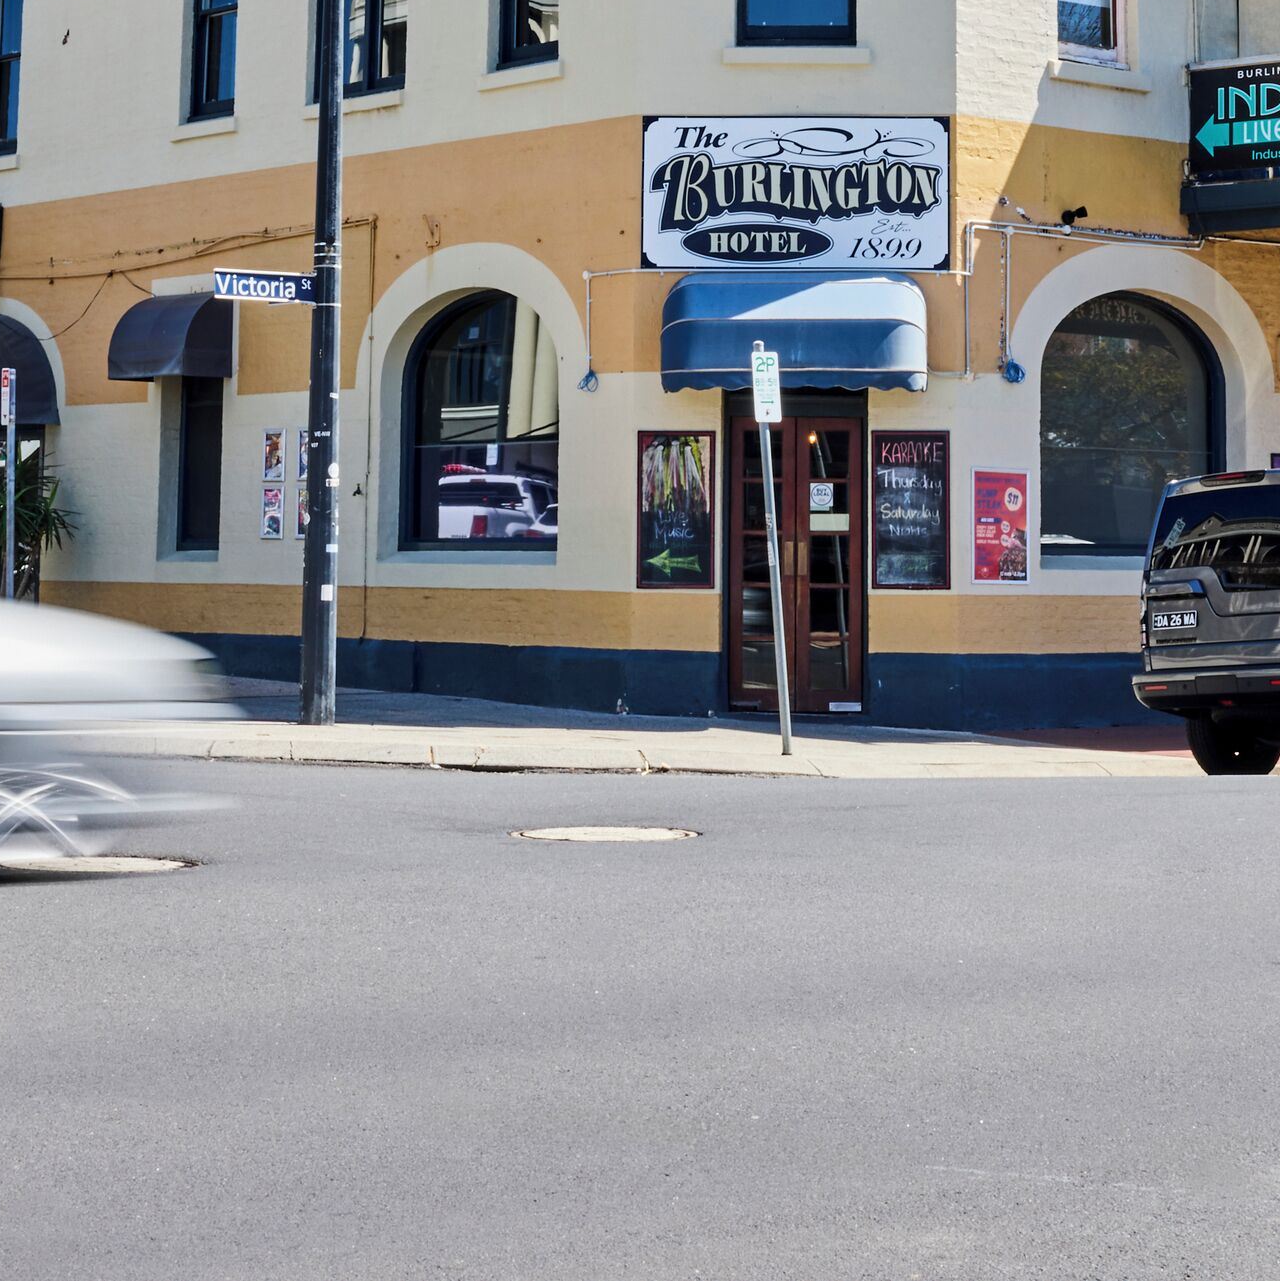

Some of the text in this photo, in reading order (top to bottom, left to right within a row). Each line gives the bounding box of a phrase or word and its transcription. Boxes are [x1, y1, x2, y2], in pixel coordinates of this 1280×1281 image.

[674, 126, 728, 148] The
[664, 154, 939, 221] BURLINGTON
[709, 232, 807, 254] HOTEL
[847, 237, 922, 259] 1899
[215, 273, 311, 298] Victoria St
[755, 356, 775, 372] 2P
[881, 441, 943, 464] KARAOKE
[877, 469, 942, 496] Thursday
[1007, 492, 1019, 505] $11
[658, 510, 689, 523] Live
[880, 503, 941, 526] Saturday
[654, 523, 695, 544] Music
[1170, 614, 1182, 626] 26
[1183, 613, 1195, 625] WA
